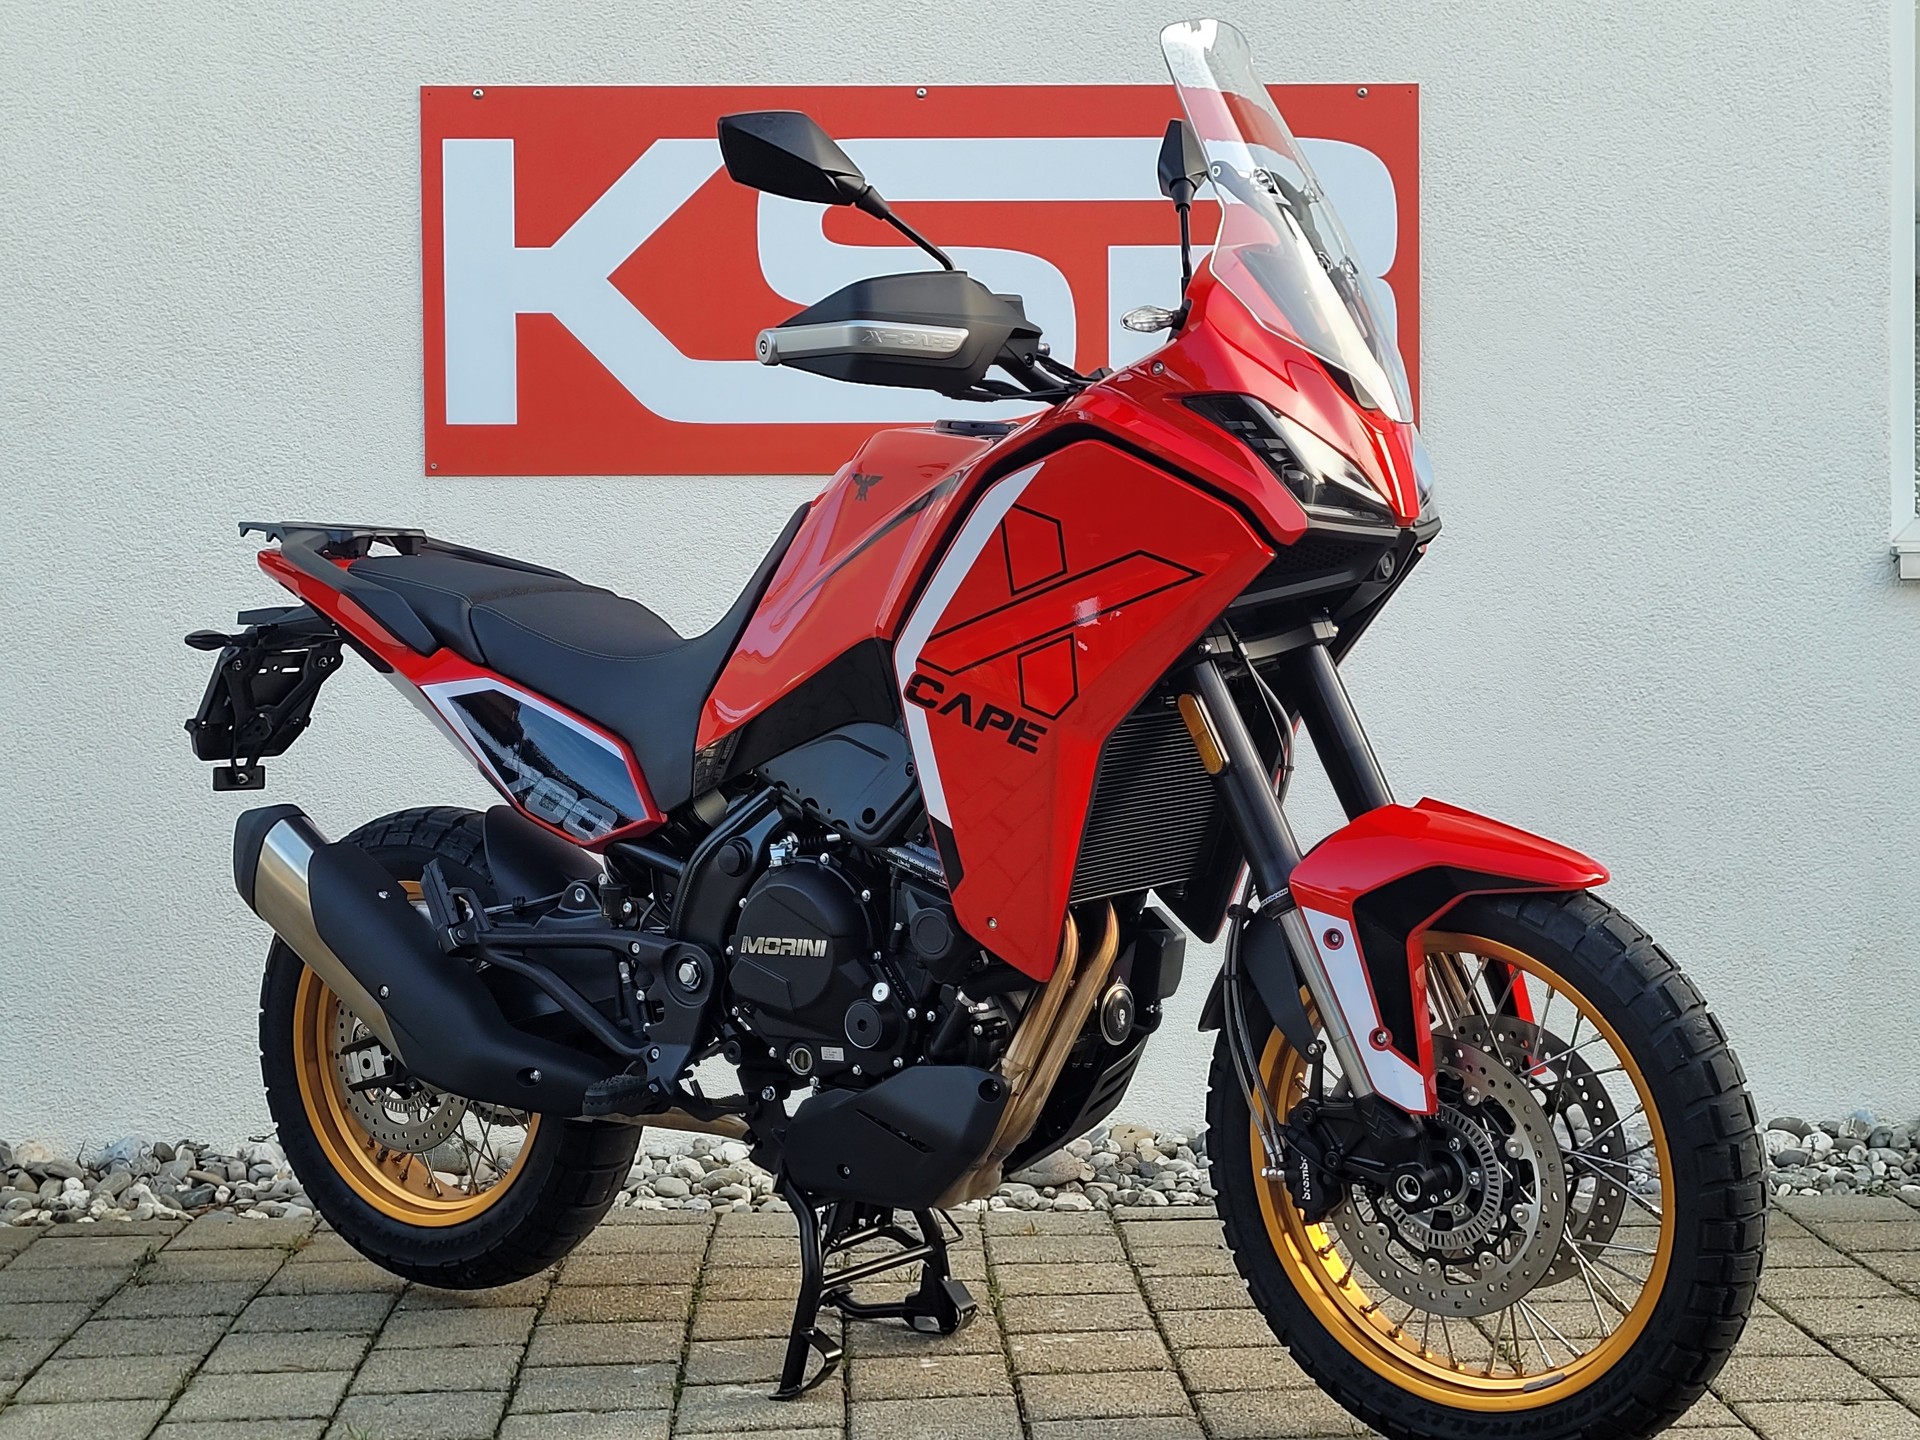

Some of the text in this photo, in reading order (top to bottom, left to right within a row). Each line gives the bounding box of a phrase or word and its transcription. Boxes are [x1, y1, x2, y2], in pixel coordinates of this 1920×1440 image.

[862, 330, 956, 349] X-CAPE
[905, 673, 1049, 754] CAPE
[503, 756, 618, 842] 700
[742, 936, 827, 957] MORINI
